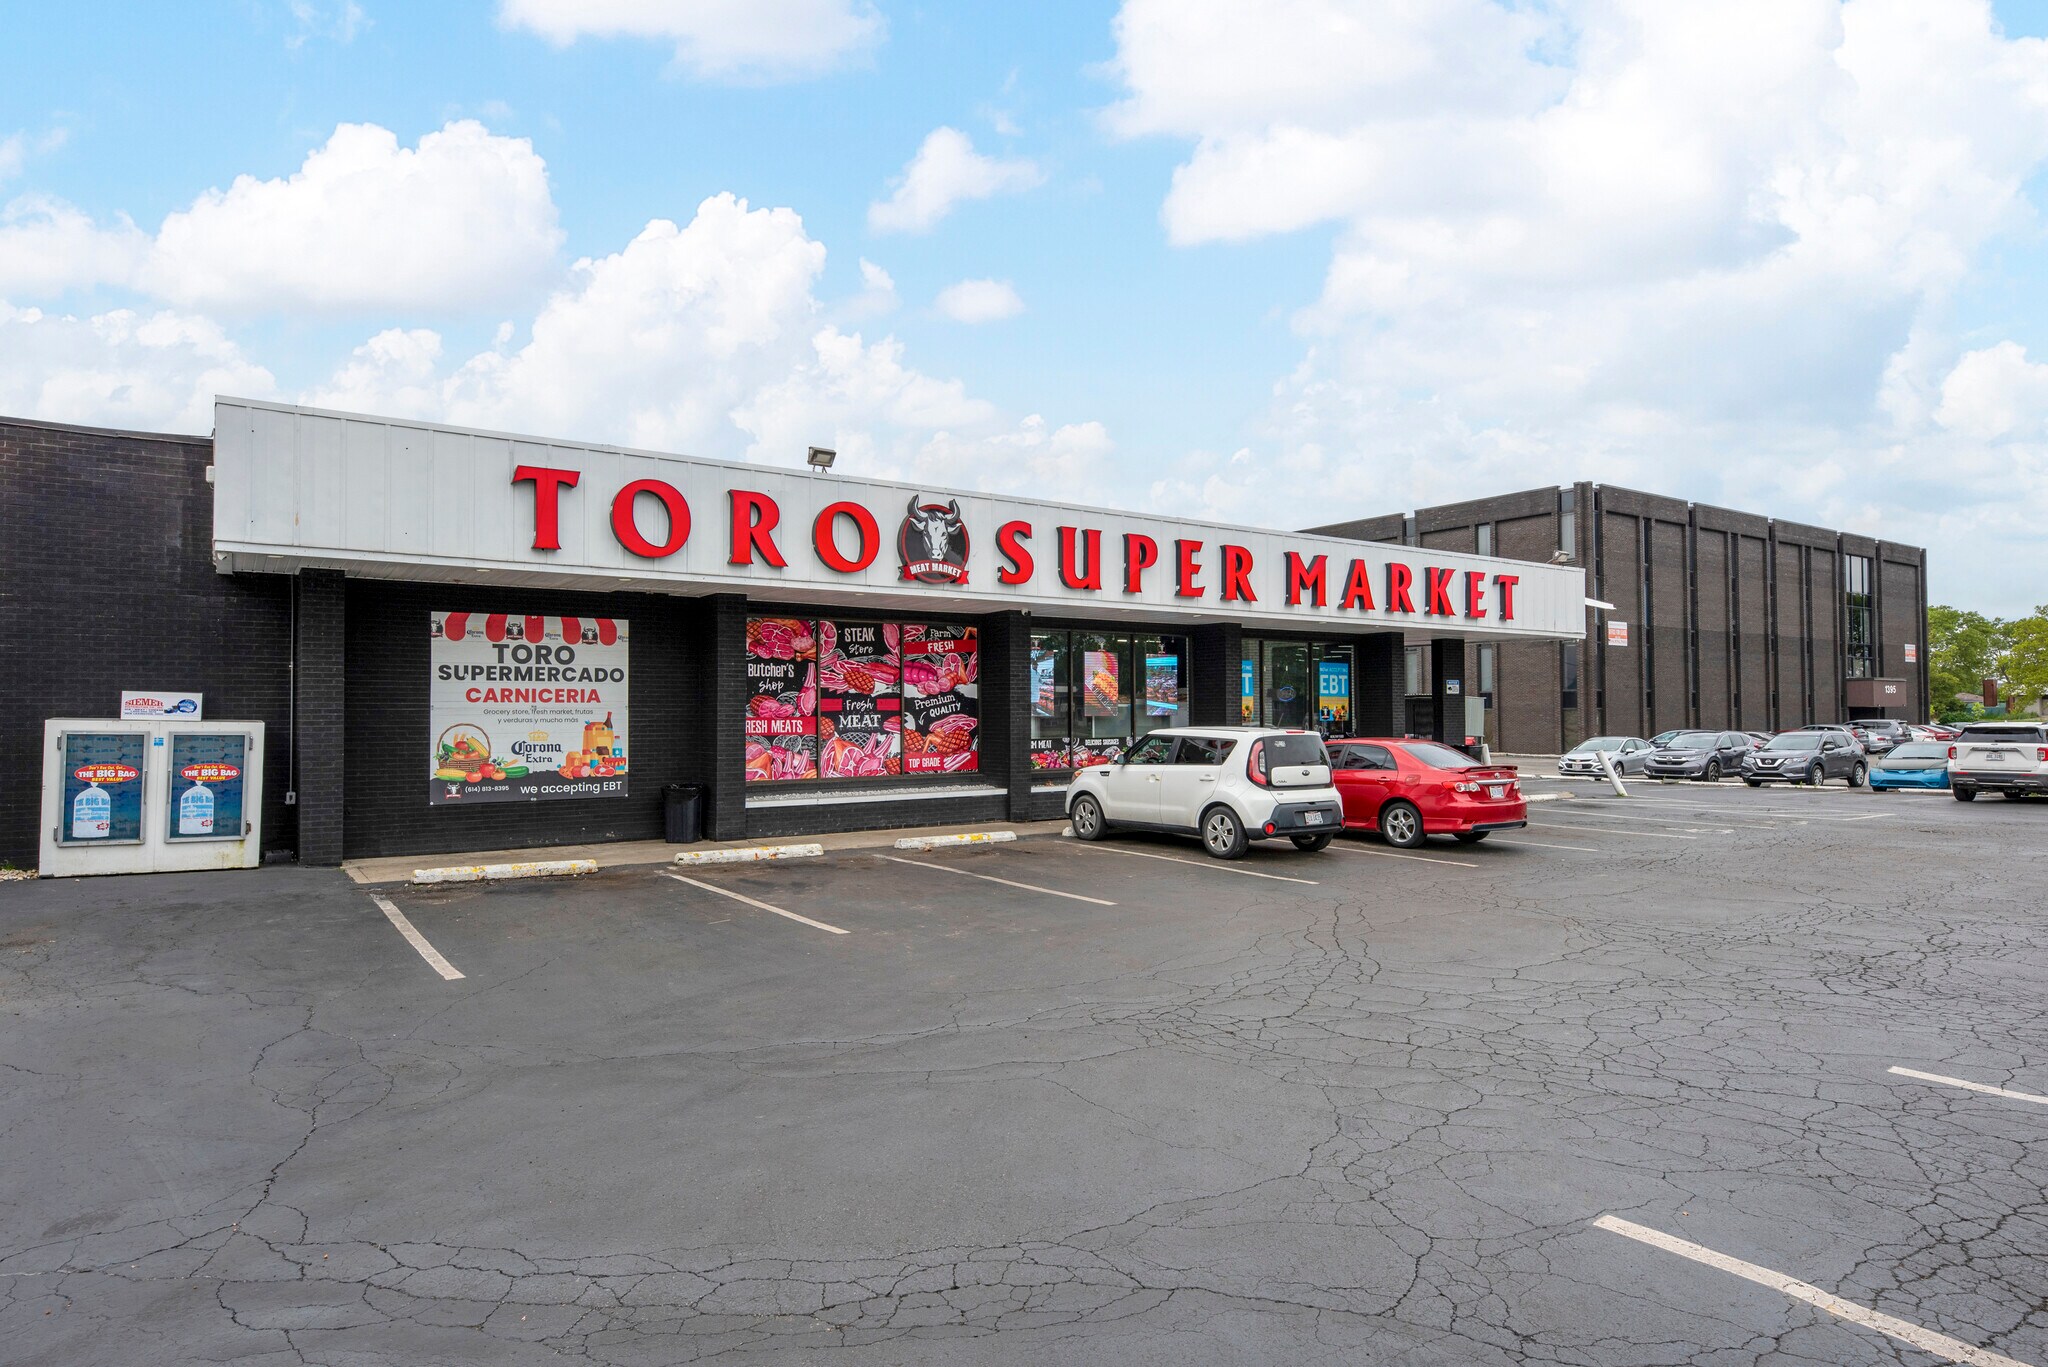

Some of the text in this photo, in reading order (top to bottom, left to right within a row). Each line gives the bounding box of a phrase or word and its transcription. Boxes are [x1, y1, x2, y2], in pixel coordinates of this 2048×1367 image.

[511, 465, 880, 573] TORO
[909, 564, 962, 578] MEAT MARKET
[995, 520, 1519, 620] SUPER MARKET
[844, 627, 876, 642] STEAK
[930, 628, 951, 639] Farm
[927, 640, 955, 653] FRESH
[492, 643, 576, 666] TORO
[438, 664, 625, 683] SUPERMERCADO
[747, 662, 795, 678] Butcher's
[1319, 669, 1348, 689] EBT
[465, 687, 602, 704] CARNICERIA
[1885, 684, 1897, 694] 1395
[125, 697, 164, 707] SIEMER
[846, 698, 875, 713] Fresh
[914, 694, 956, 710] Premium
[483, 708, 510, 716] Grocery
[929, 702, 962, 718] QUALITY
[746, 719, 803, 734] RESH MEATS
[839, 714, 881, 728] MEAT
[511, 740, 562, 757] Corona
[1038, 740, 1053, 749] MEAT
[525, 753, 553, 763] Extra
[908, 757, 941, 768] TOP GRADE
[97, 769, 115, 778] BIG
[117, 770, 136, 778] BAG
[201, 768, 219, 776] BIG
[464, 785, 481, 794] (614)
[520, 781, 623, 796] we accepting EBT
[85, 797, 100, 806] BIG
[190, 795, 204, 803] BIG
